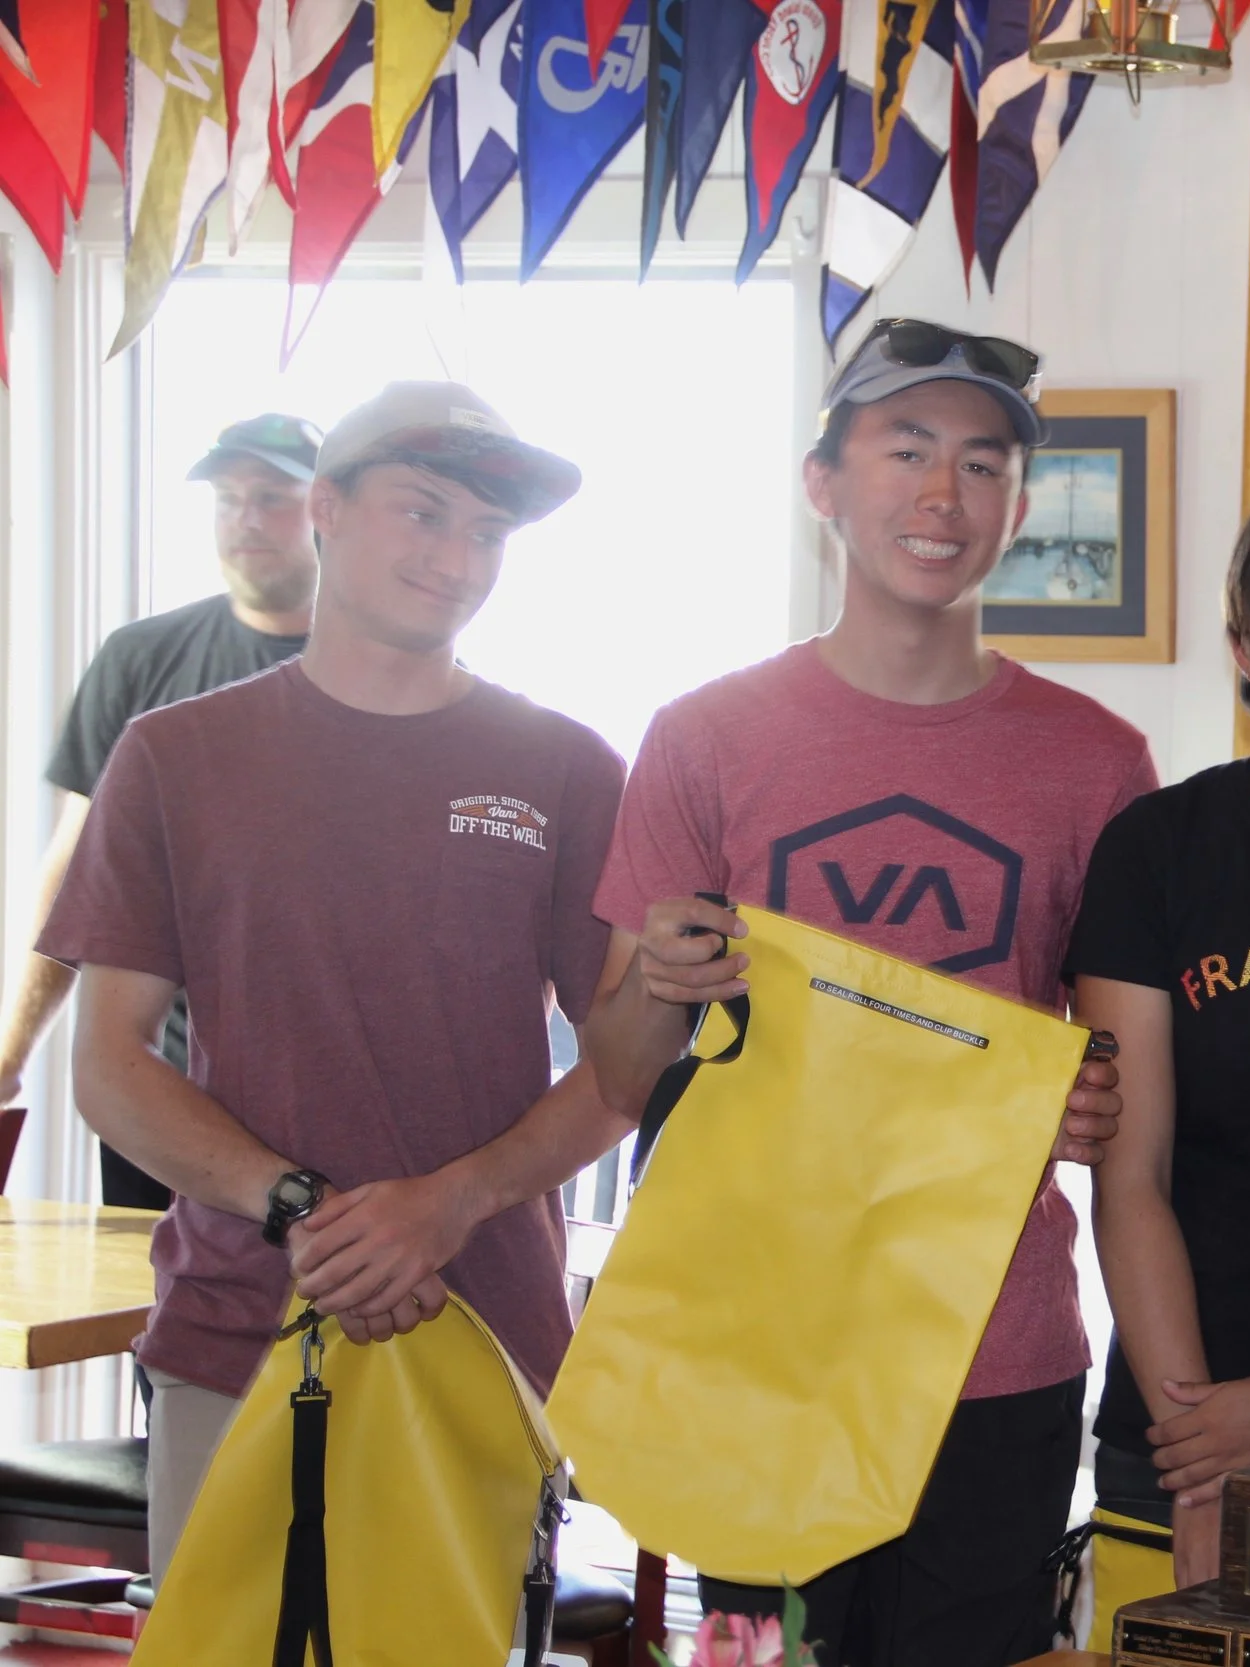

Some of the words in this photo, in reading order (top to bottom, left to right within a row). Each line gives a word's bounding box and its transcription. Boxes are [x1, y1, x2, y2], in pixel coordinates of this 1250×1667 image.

[450, 795, 500, 810] ORIGINAL
[501, 796, 530, 813] SINCE
[487, 805, 519, 820] Vans
[450, 813, 479, 833] OFF
[480, 818, 510, 839] THE
[512, 824, 546, 851] WALL
[814, 979, 826, 990] TO
[826, 984, 847, 999] SEAL
[847, 991, 868, 1006] ROLL
[868, 1000, 892, 1014] FOUR
[892, 1008, 917, 1023] TIMES
[916, 1016, 934, 1029] AND
[934, 1023, 953, 1035] CLIP
[953, 1030, 985, 1047] BUCKLE
